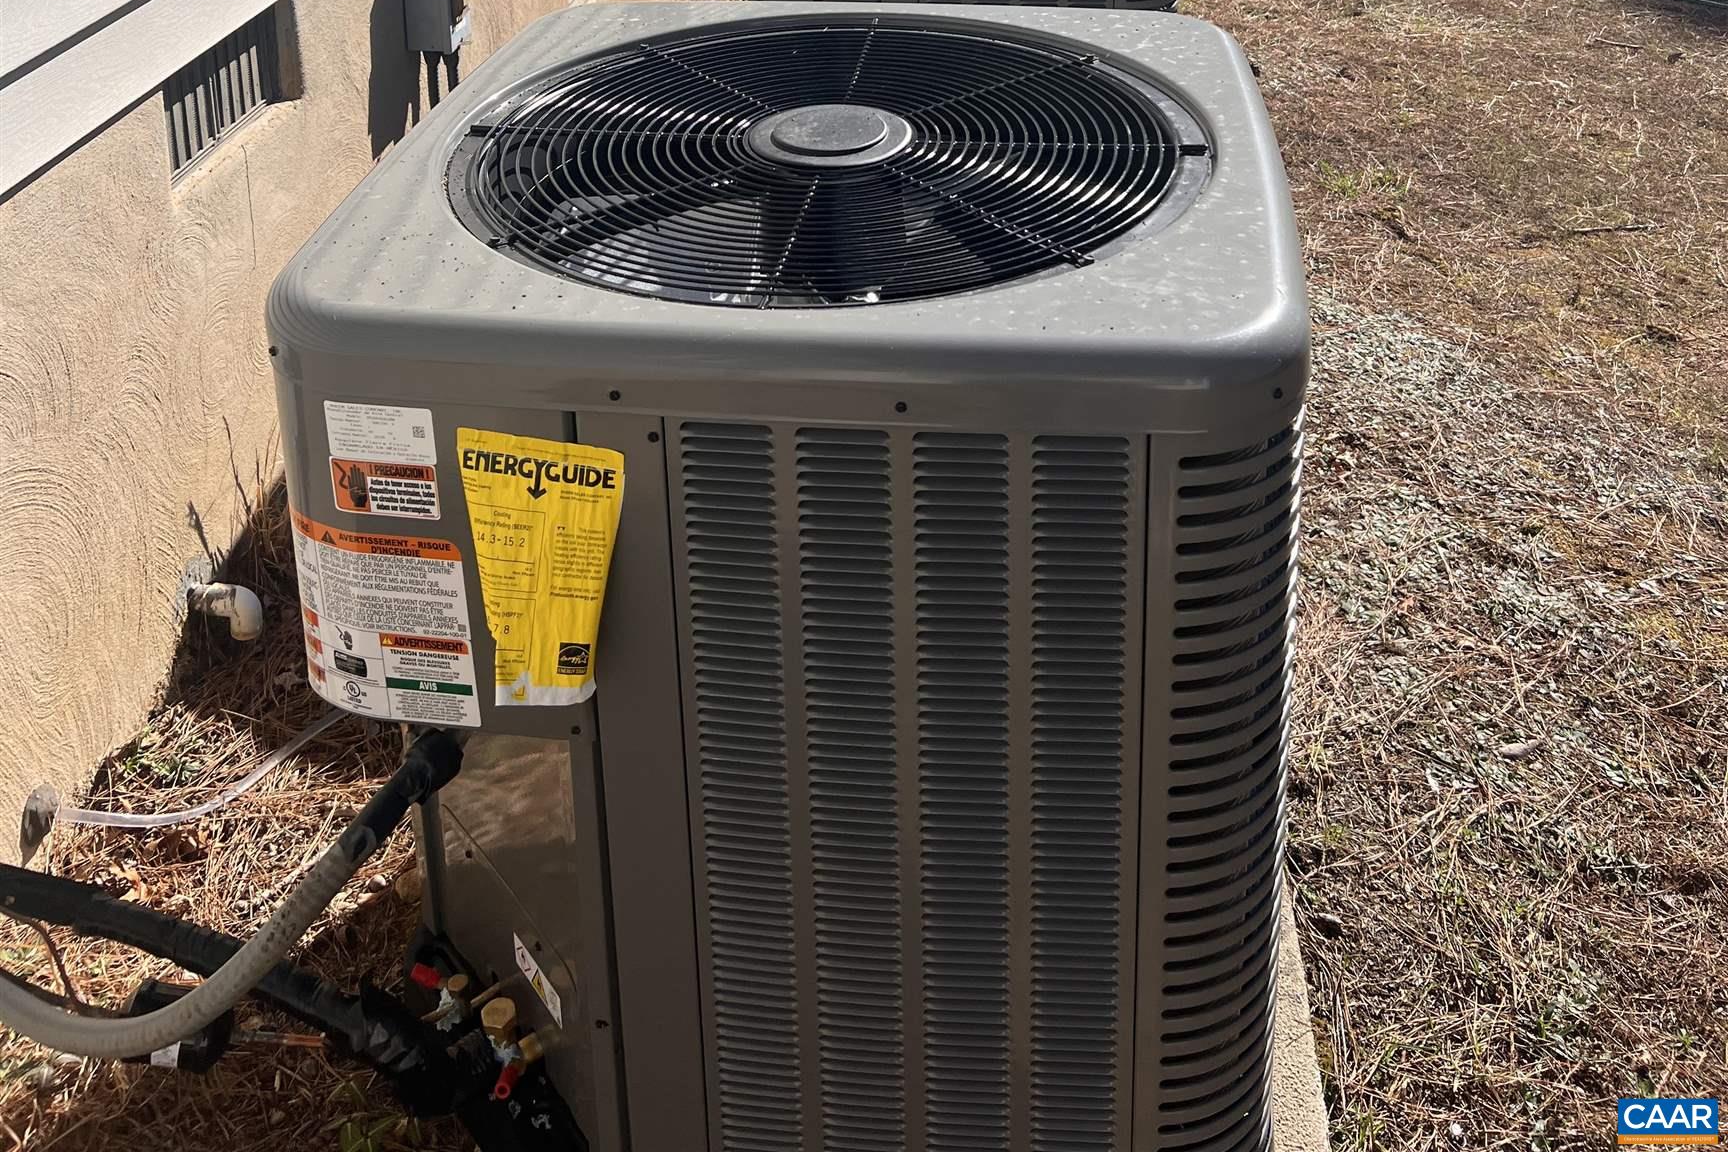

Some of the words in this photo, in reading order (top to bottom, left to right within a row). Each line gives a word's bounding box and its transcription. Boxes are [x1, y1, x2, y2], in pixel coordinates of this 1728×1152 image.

[338, 533, 409, 547] AVERTISSEMENT
[417, 541, 451, 552] RISQUE
[371, 546, 421, 557] D'INCENDIE
[394, 636, 463, 652] ADVERTISSEMENT
[390, 649, 417, 657] TENSION
[418, 651, 459, 660] DANGEREUSE
[419, 681, 438, 691] AVIS
